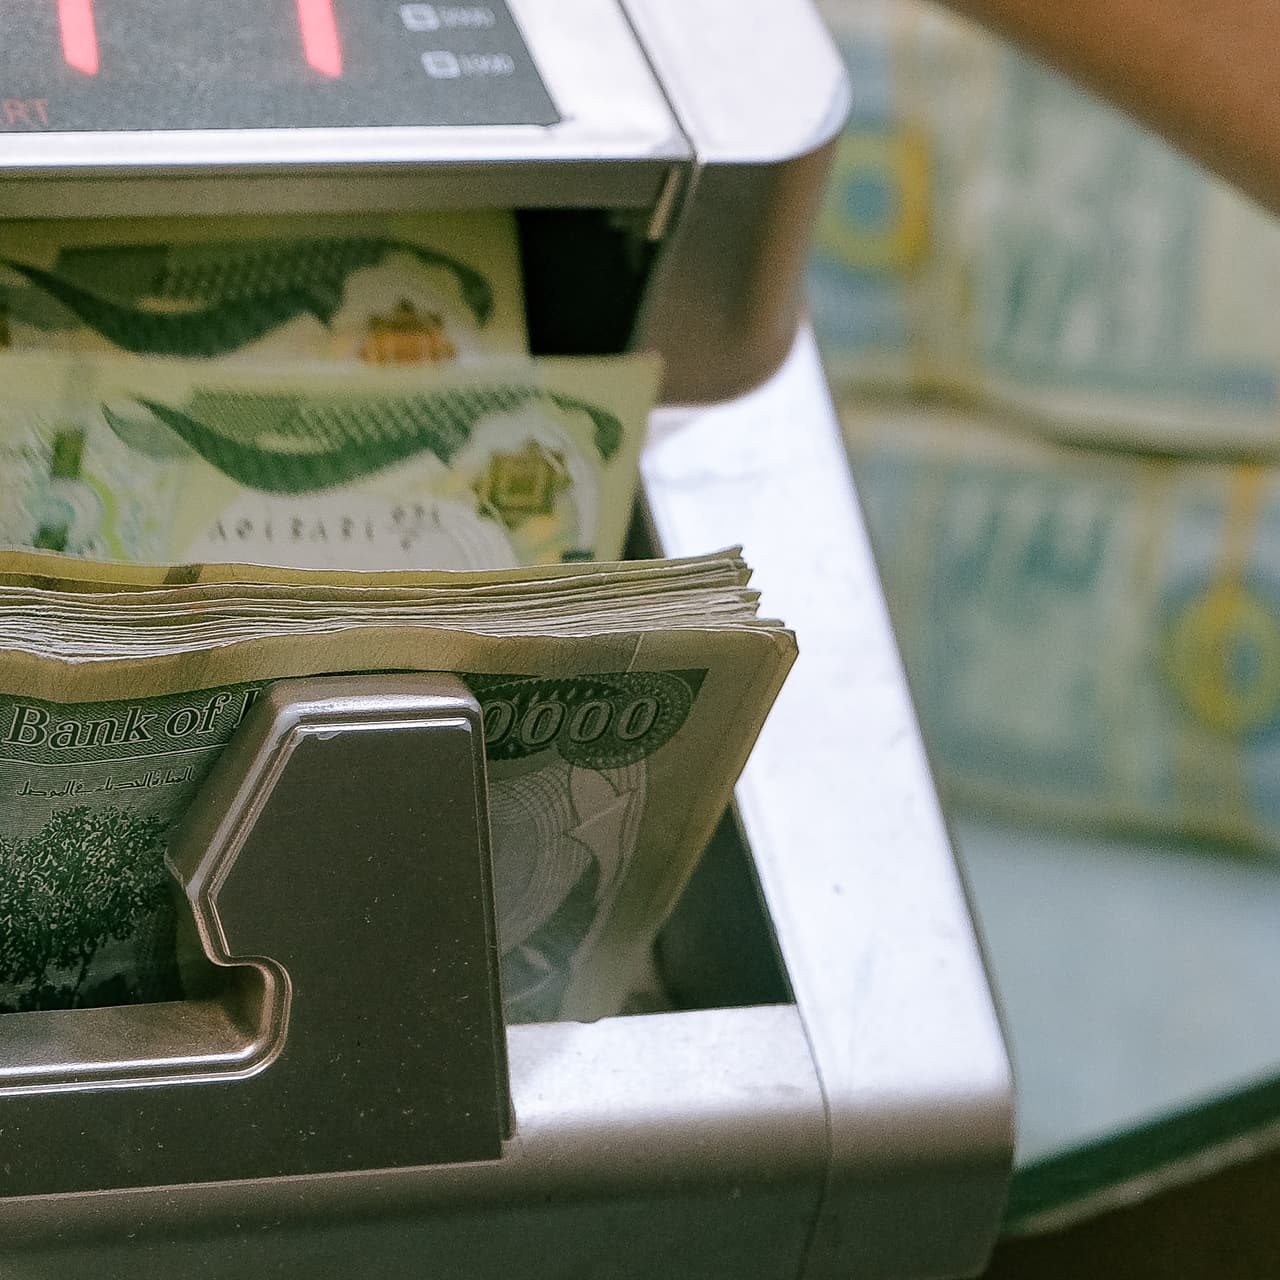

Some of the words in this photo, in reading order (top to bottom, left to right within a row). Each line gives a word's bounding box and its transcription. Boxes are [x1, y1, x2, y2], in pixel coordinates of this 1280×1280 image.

[2, 702, 159, 751] Bank
[165, 691, 230, 739] of
[483, 695, 663, 747] 0000
[16, 780, 78, 800] الموصل
